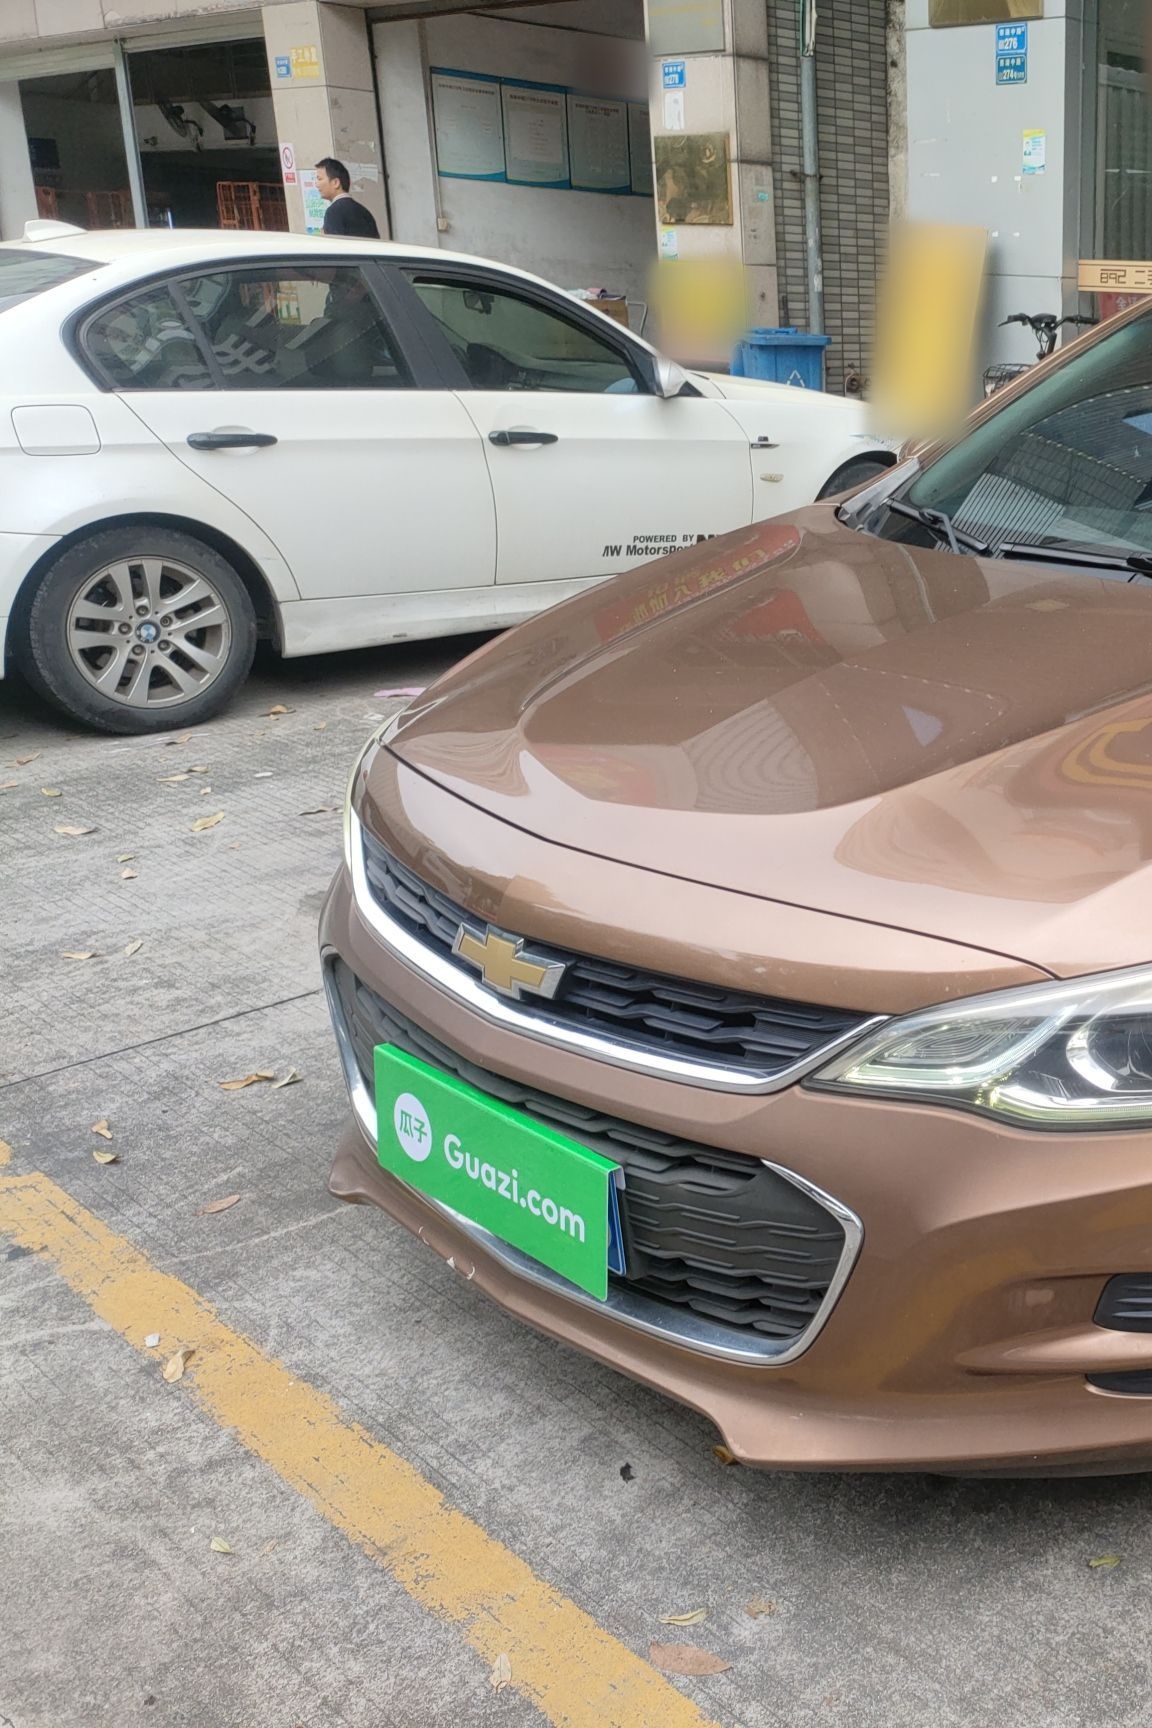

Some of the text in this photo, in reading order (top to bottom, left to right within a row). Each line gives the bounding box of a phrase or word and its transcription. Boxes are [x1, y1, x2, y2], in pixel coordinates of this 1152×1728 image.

[1004, 37, 1018, 50] 276
[632, 534, 678, 544] POWERED
[682, 534, 695, 543] BY
[400, 1109, 428, 1143] 瓜子
[443, 1133, 586, 1243] Guazi.com
